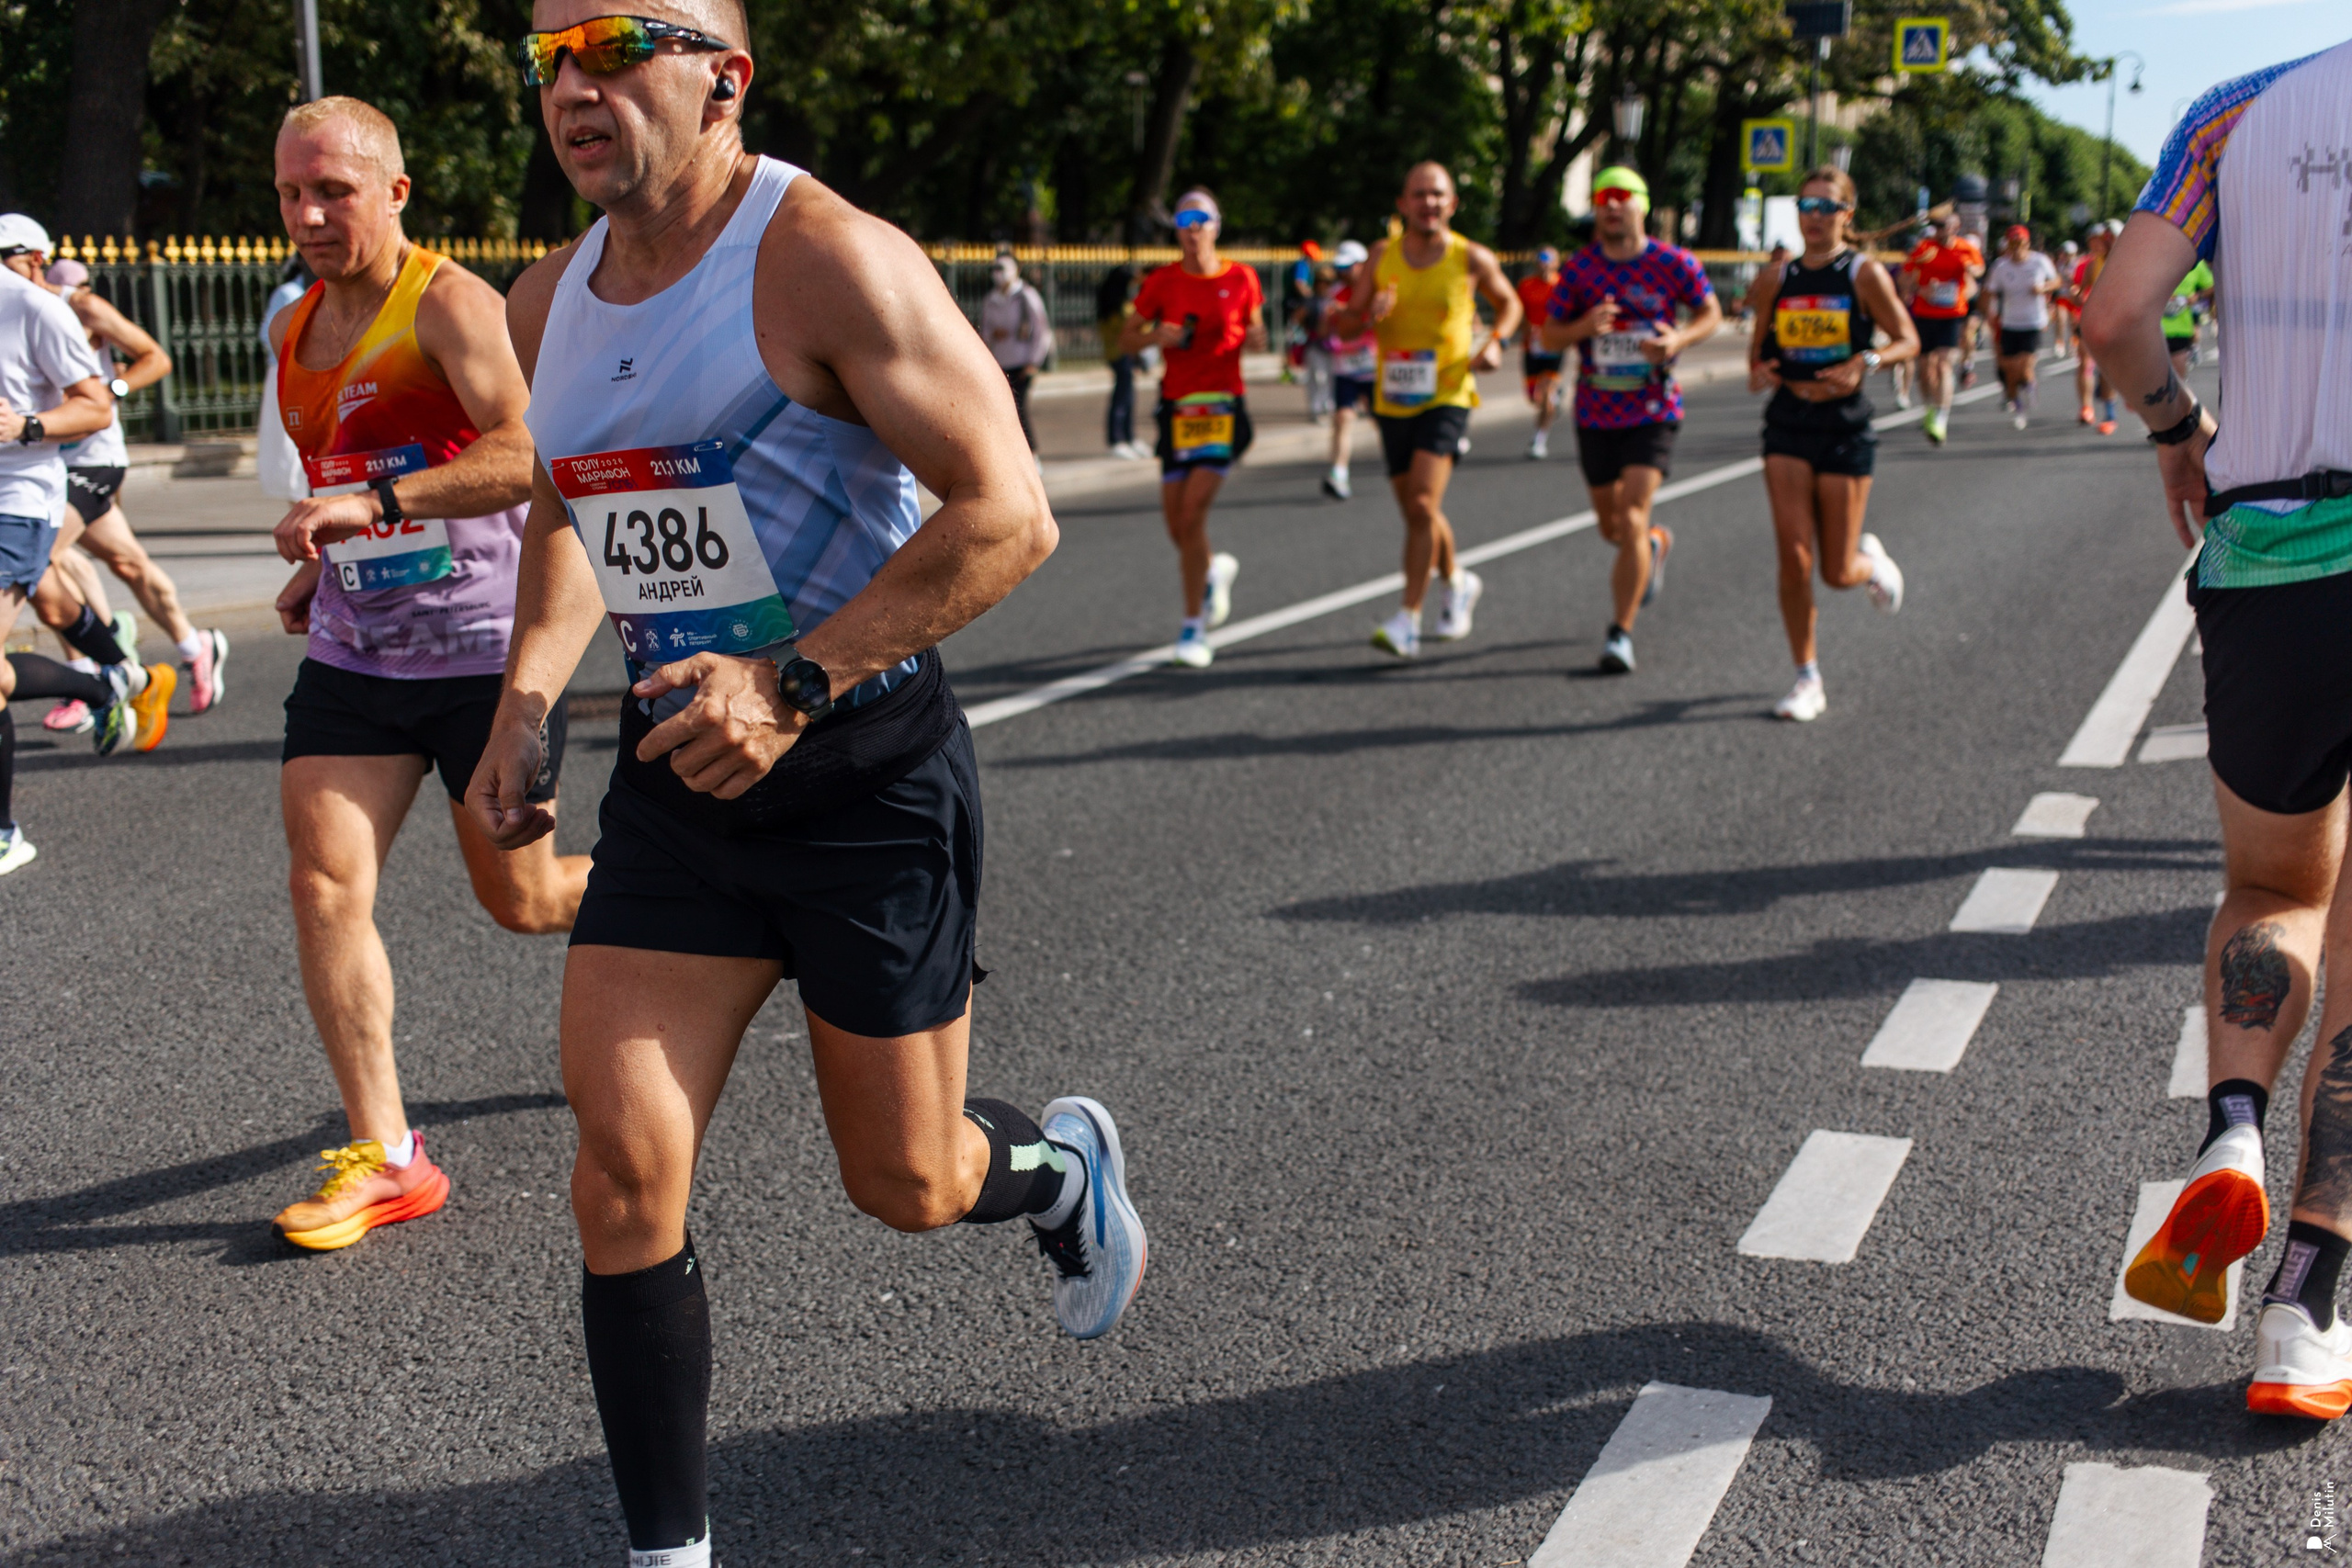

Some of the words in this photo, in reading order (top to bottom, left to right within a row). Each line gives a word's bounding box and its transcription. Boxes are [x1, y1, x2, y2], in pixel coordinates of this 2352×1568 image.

[571, 458, 599, 472] ПОЛУ
[602, 457, 624, 467] 2026
[650, 459, 674, 477] 21,1
[576, 467, 631, 484] МАРАФОН
[604, 506, 729, 576] 4386
[639, 575, 705, 603] АНДРЕЙ
